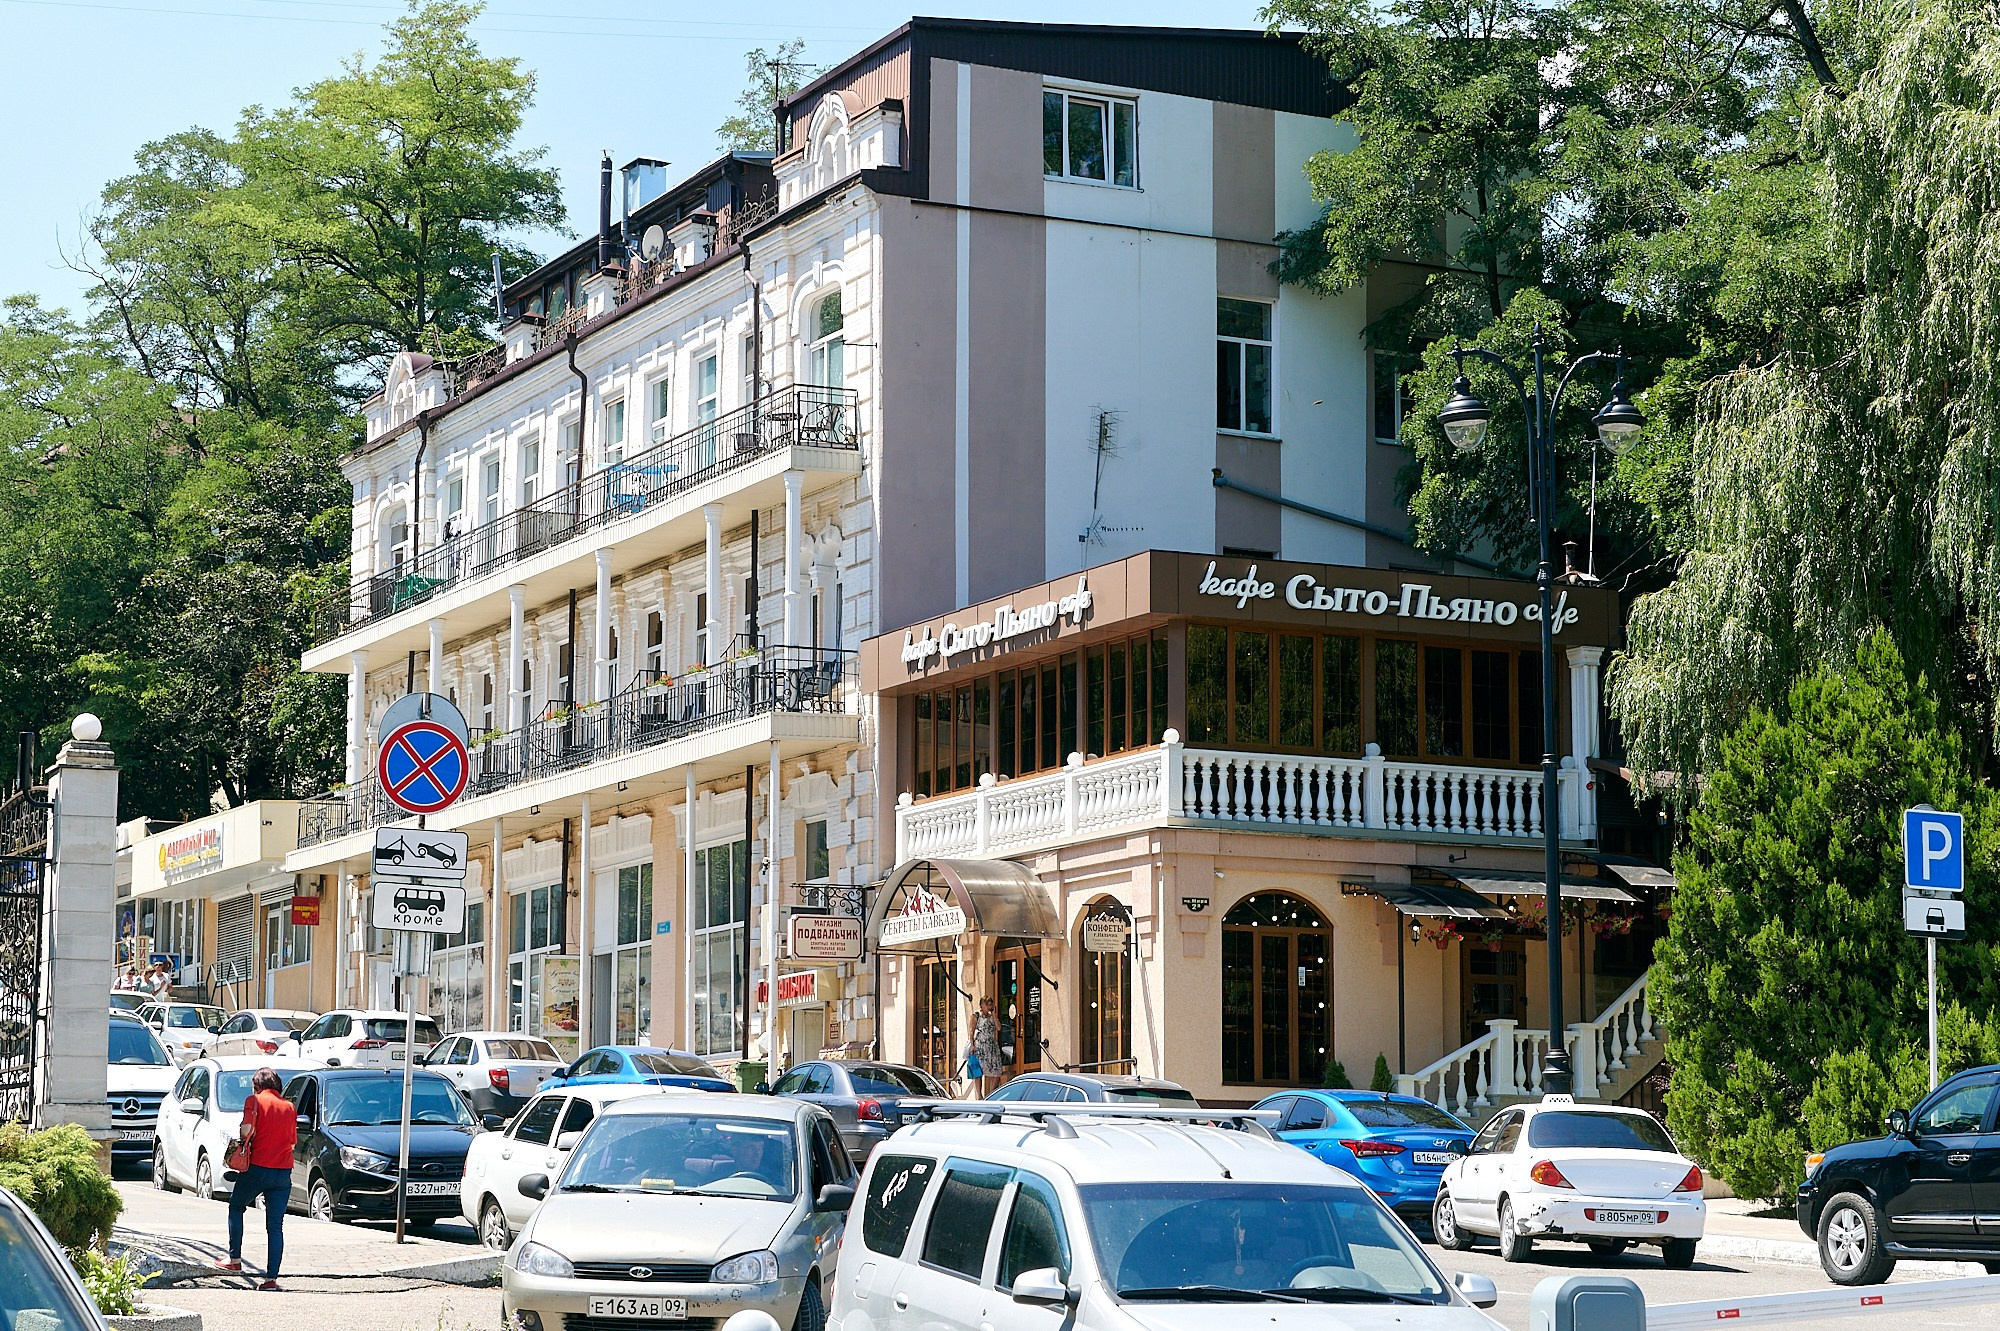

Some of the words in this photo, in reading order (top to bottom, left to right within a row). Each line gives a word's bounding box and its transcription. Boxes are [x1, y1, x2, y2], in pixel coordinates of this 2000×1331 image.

[1199, 560, 1275, 610] кафе
[1285, 574, 1518, 626] Сыто-Пьяно
[901, 625, 938, 670] кафе
[938, 601, 1058, 657] Сыто-Пьяно
[1058, 576, 1092, 624] cafe
[203, 828, 217, 846] МИР
[393, 914, 443, 926] кроме
[814, 919, 842, 927] МАГАЗИН
[884, 917, 921, 936] СЕКРЕТЫ
[922, 911, 960, 930] КАВКАЗА
[1087, 924, 1124, 932] КОНФЕТЫ
[797, 928, 859, 940] ПОДВАЛЬЧИК
[138, 937, 147, 974] ПИВ
[756, 973, 815, 1003] ПОАЛЬЧИК
[665, 1299, 681, 1311] 09
